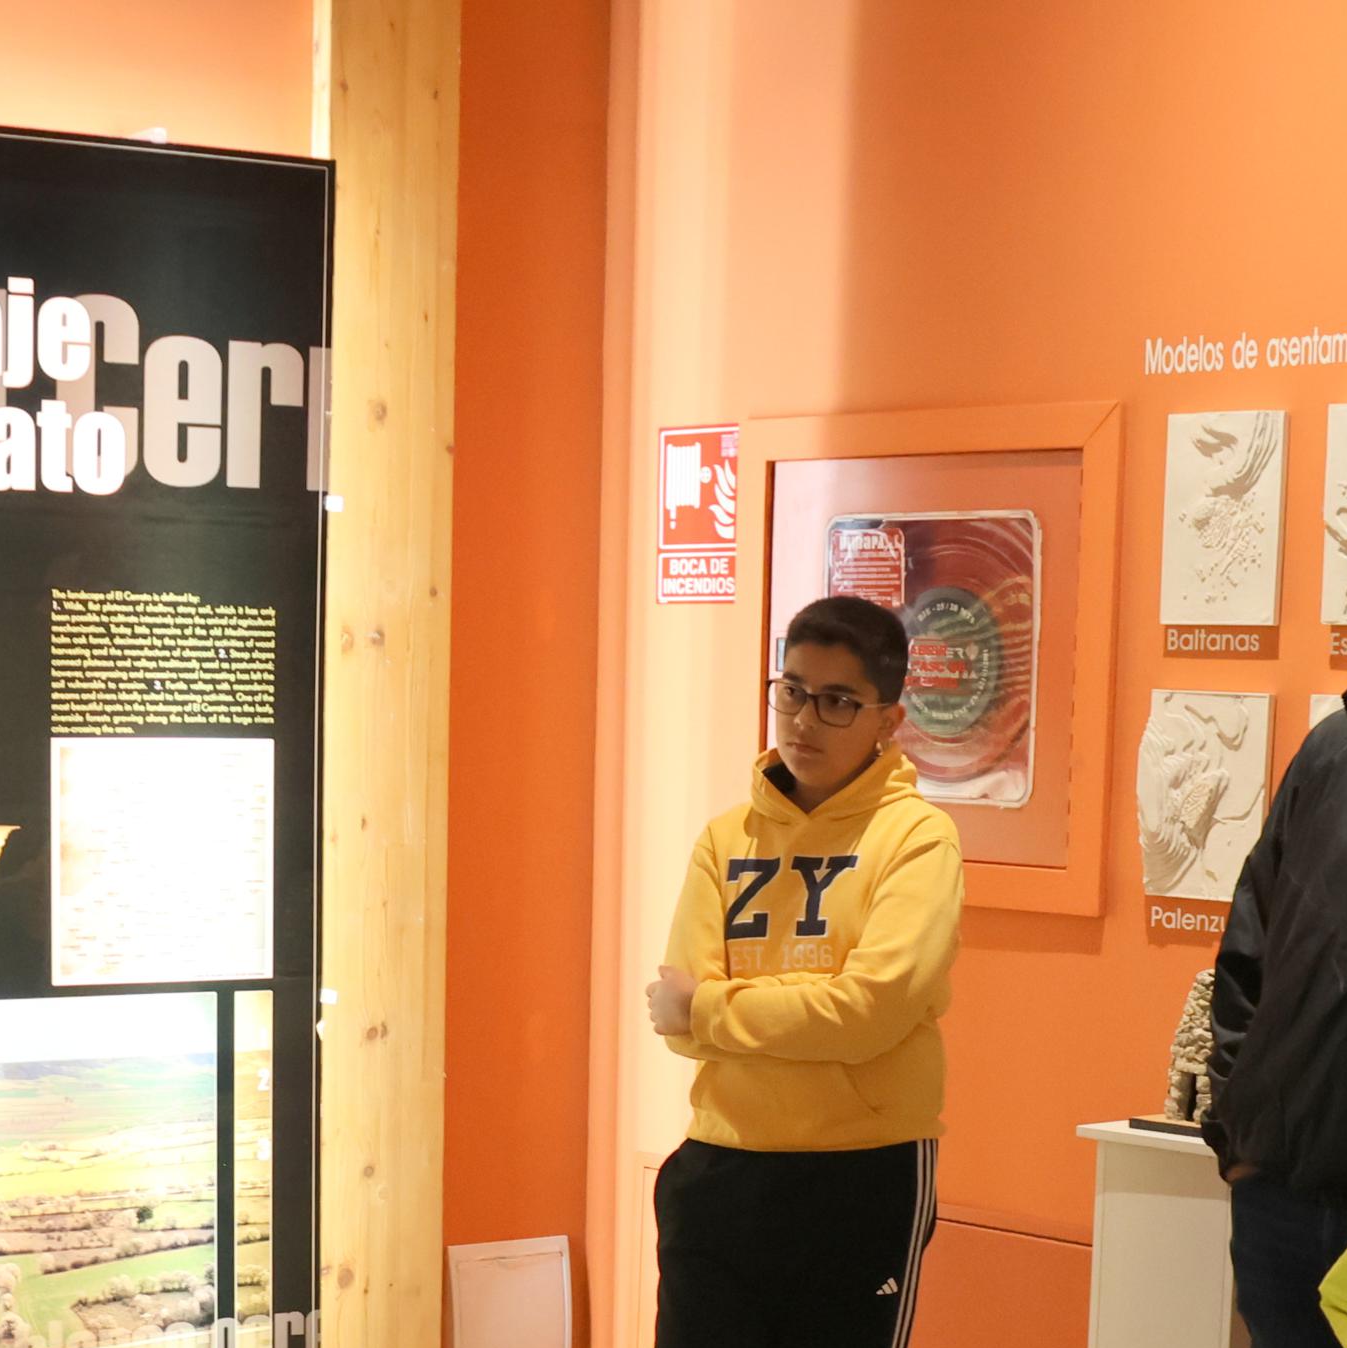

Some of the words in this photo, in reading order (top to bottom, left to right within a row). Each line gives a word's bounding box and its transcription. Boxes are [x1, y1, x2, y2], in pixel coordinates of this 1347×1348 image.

[1145, 337, 1224, 375] Modelos
[1232, 332, 1258, 369] de
[669, 558, 707, 575] BOCA
[710, 557, 729, 575] DE
[663, 577, 735, 594] INCENDIOS
[1167, 629, 1260, 652] Baltanas
[725, 855, 859, 941] ZY
